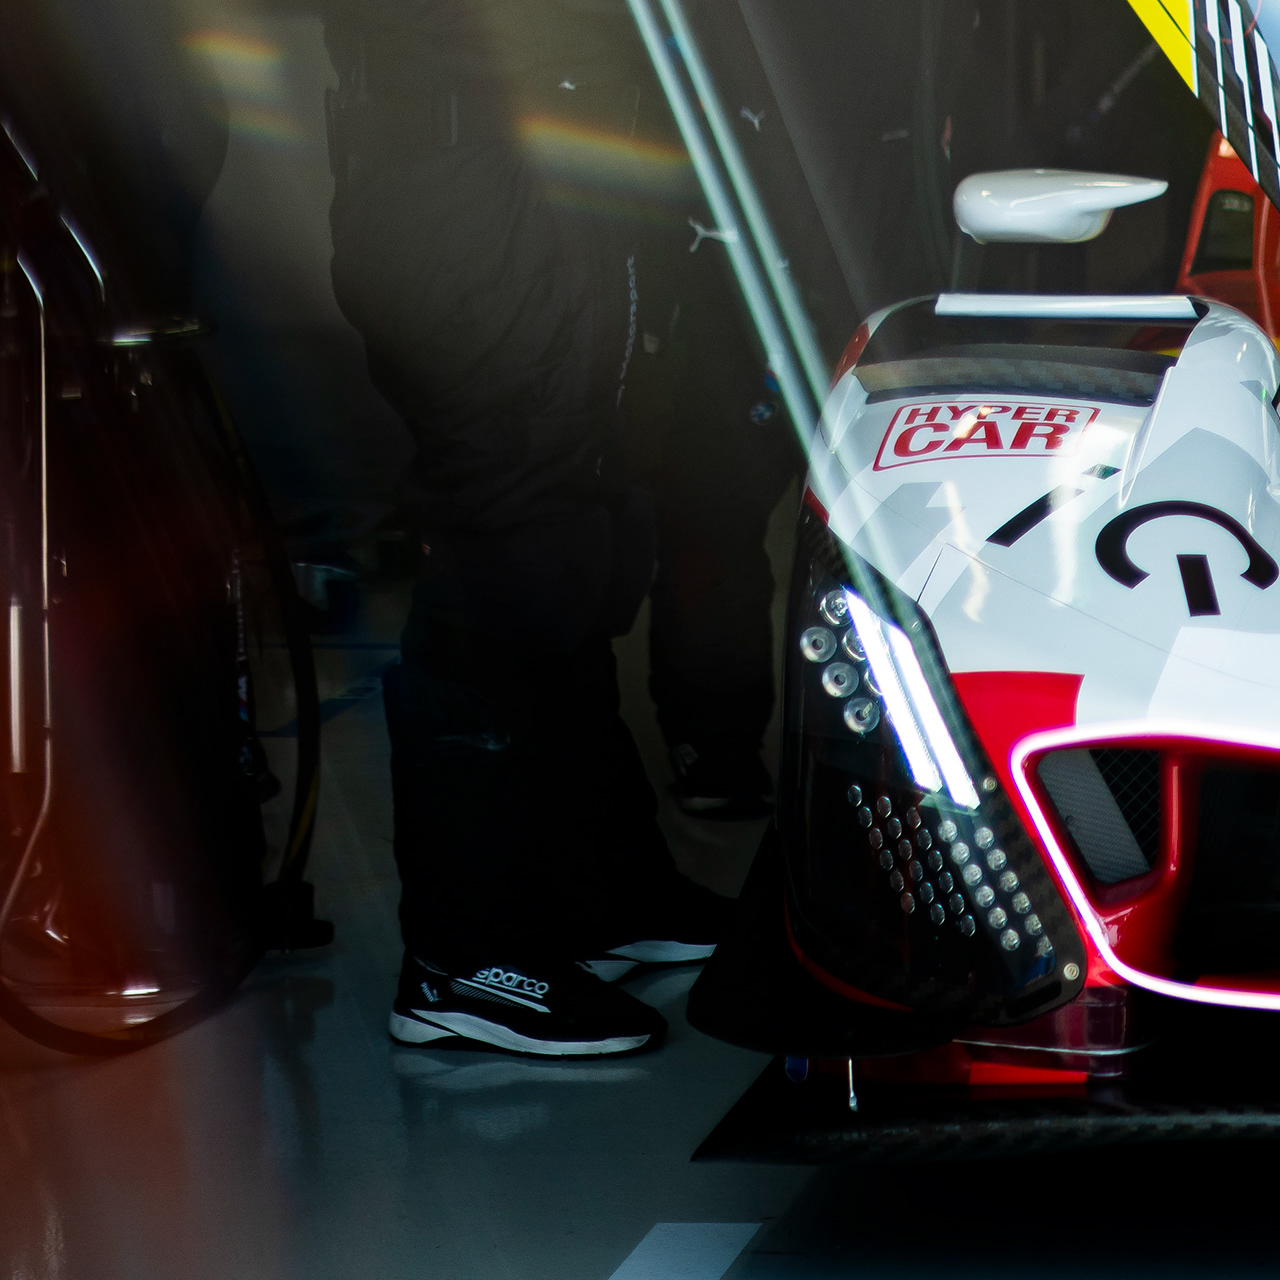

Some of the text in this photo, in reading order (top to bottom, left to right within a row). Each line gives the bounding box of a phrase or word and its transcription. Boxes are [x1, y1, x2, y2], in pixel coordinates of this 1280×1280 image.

[904, 404, 1080, 426] HYPER
[893, 421, 1071, 458] CAR
[475, 966, 550, 995] sparco
